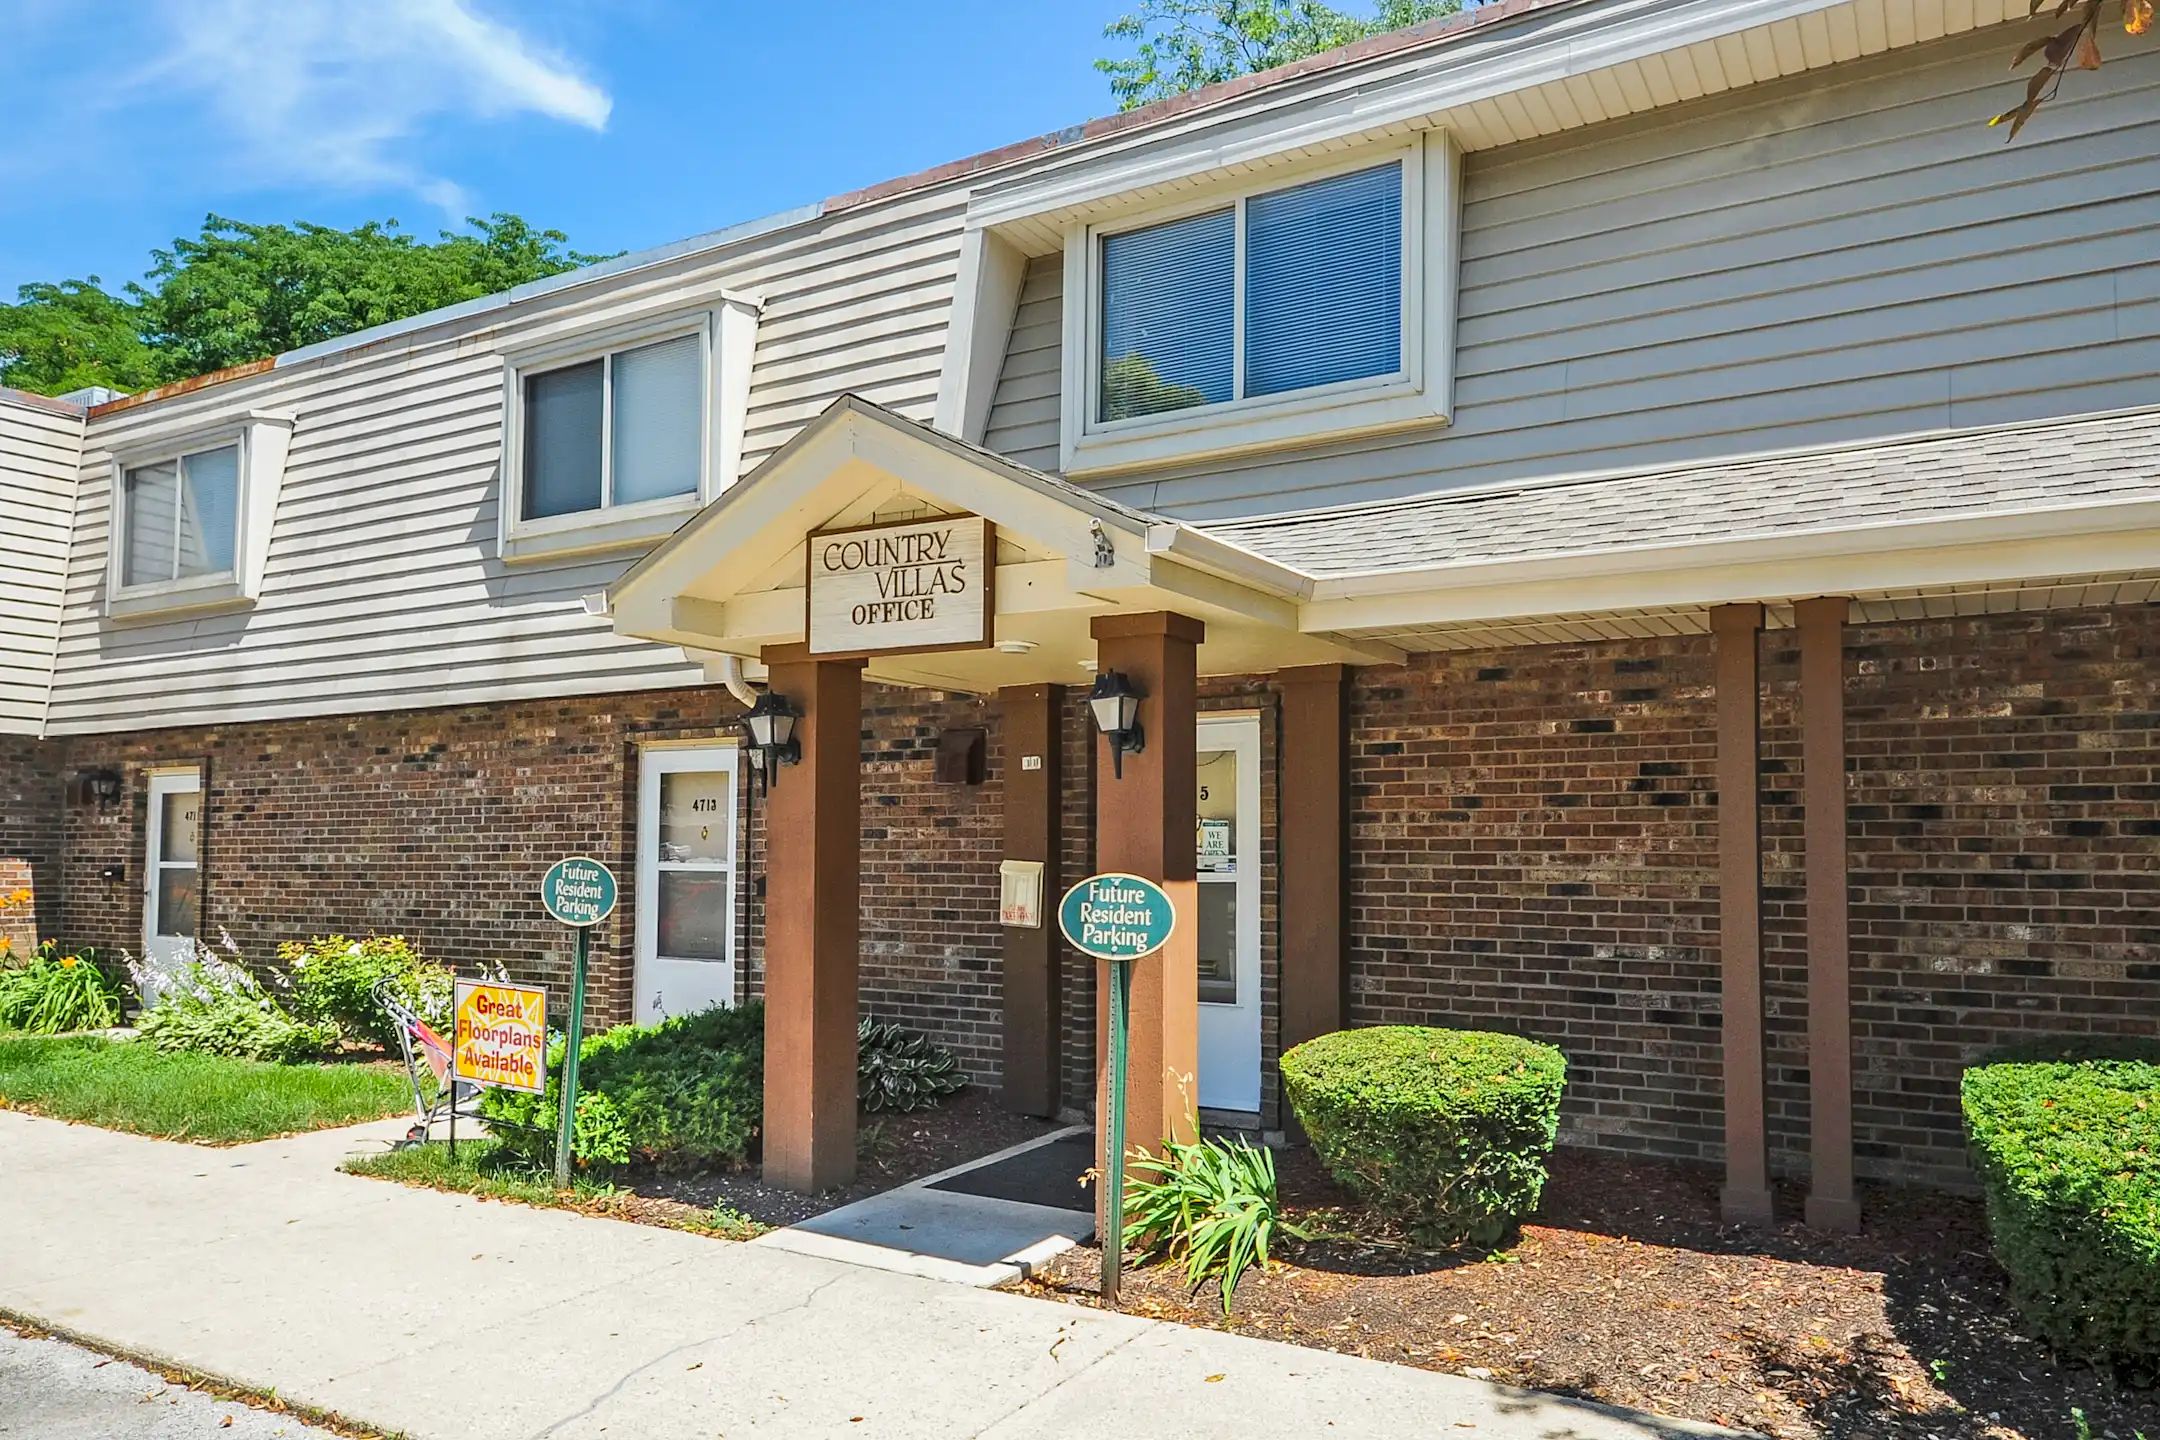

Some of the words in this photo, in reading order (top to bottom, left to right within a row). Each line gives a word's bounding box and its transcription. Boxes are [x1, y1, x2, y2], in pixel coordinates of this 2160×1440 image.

[823, 528, 952, 571] COUNTRY
[875, 562, 966, 599] VILLAS
[852, 598, 934, 625] OFFICE
[692, 799, 717, 811] 4713
[1206, 841, 1224, 849] ARE
[1208, 831, 1223, 839] WE
[562, 863, 599, 882] Future
[555, 879, 603, 899] Resident
[1089, 882, 1145, 904] Future
[556, 896, 599, 920] Parking
[1080, 902, 1152, 926] Resident
[1083, 924, 1148, 953] Parking
[477, 994, 523, 1019] Great
[459, 1019, 542, 1049] Floorplans
[464, 1046, 533, 1075] Available
